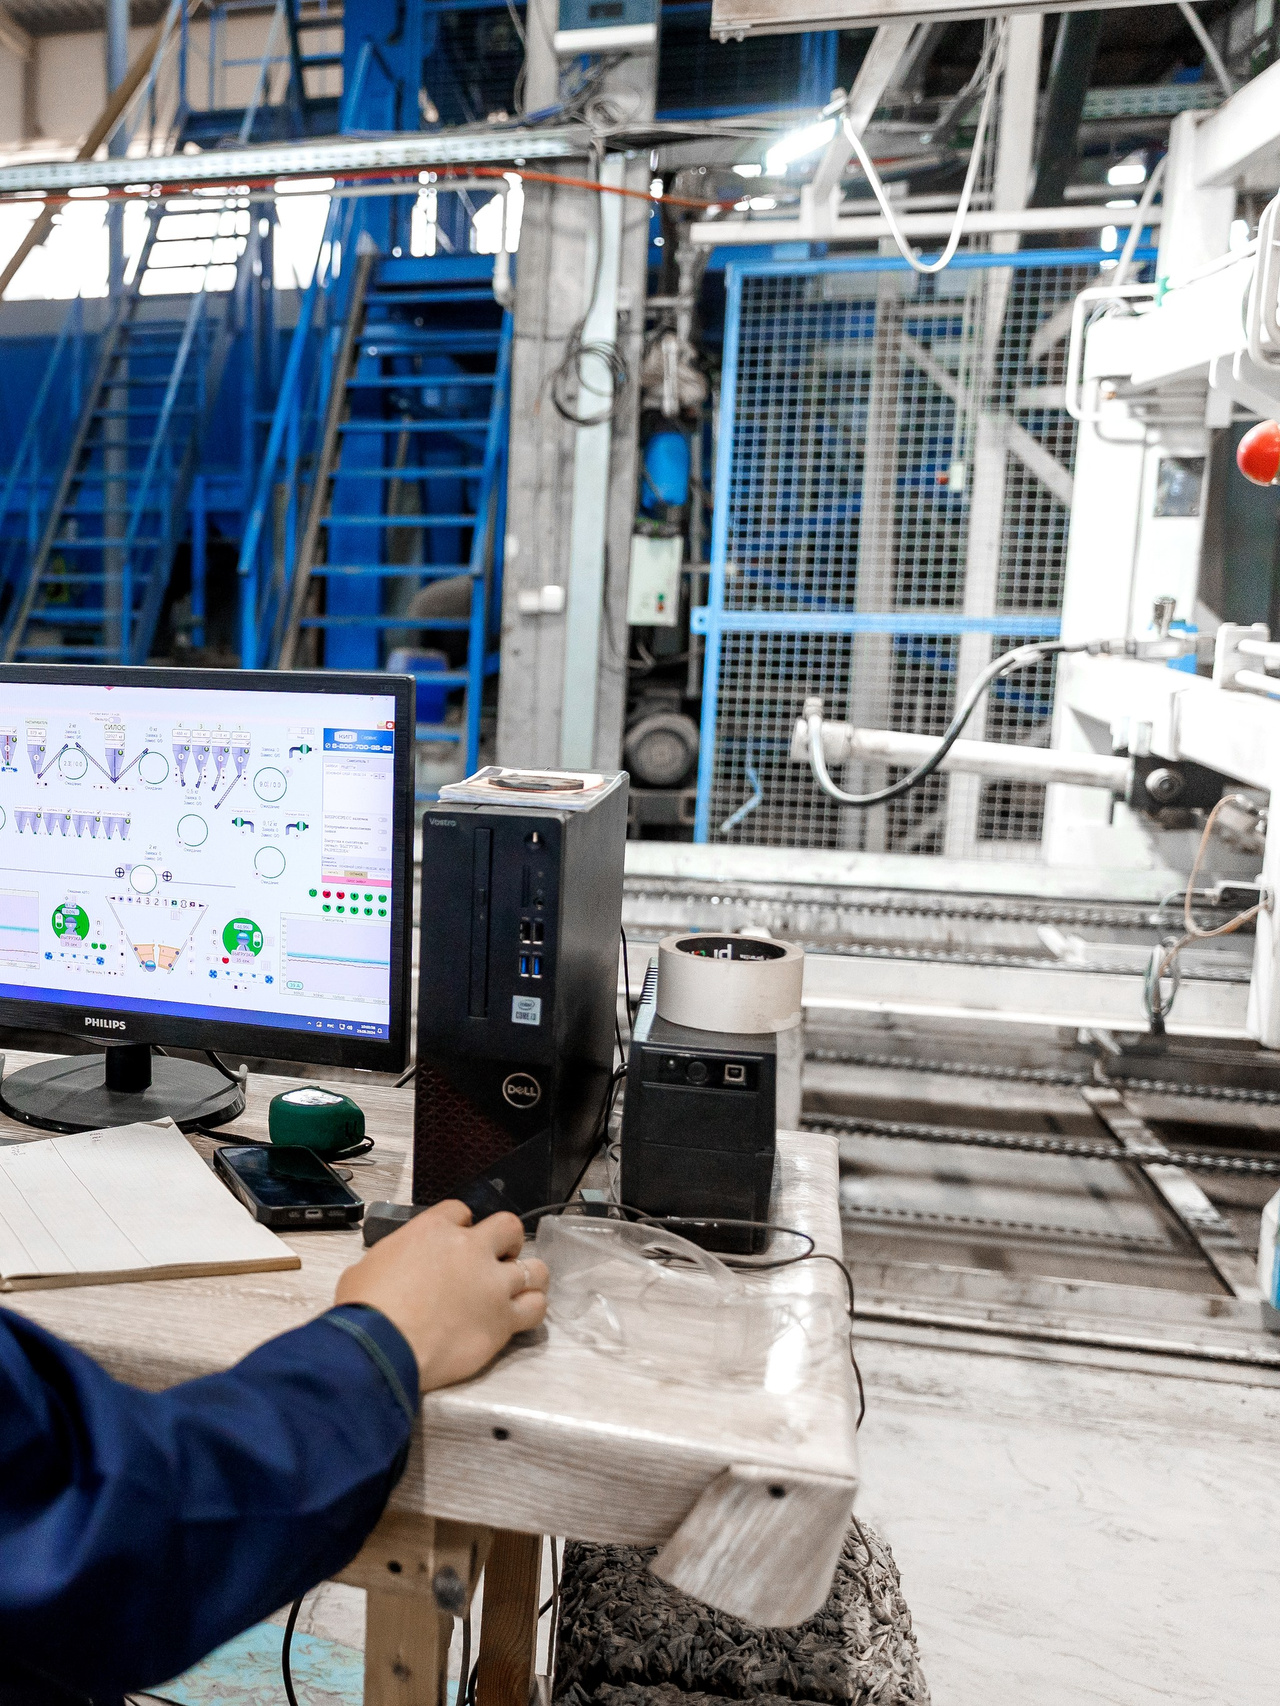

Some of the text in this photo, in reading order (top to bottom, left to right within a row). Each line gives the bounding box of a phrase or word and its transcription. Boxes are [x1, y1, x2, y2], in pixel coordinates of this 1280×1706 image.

[429, 818, 456, 827] Vostro
[516, 1011, 528, 1020] CORE
[85, 1017, 126, 1030] PHILIPS
[508, 1085, 536, 1097] DELL
